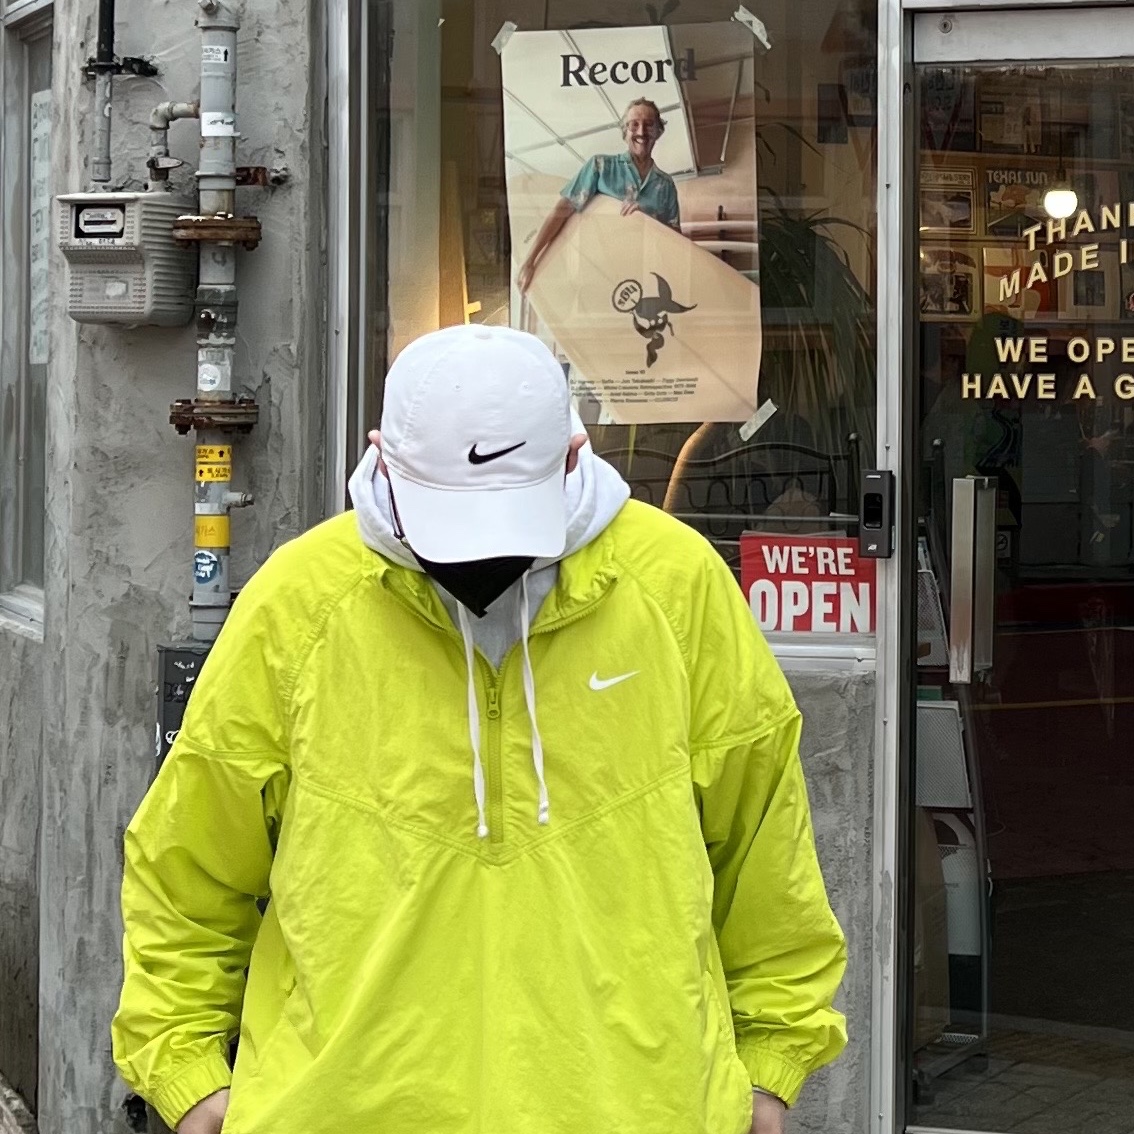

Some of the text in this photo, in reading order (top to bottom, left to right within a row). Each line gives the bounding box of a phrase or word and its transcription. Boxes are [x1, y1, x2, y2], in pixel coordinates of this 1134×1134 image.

[560, 48, 698, 87] Record
[987, 170, 1022, 184] TEXAS
[1025, 171, 1049, 185] SUN
[998, 244, 1100, 303] MADE
[995, 338, 1048, 363] WE
[962, 374, 1057, 399] HAVE
[1072, 375, 1097, 399] A
[761, 545, 855, 575] WE'RE
[749, 578, 871, 633] OPEN
